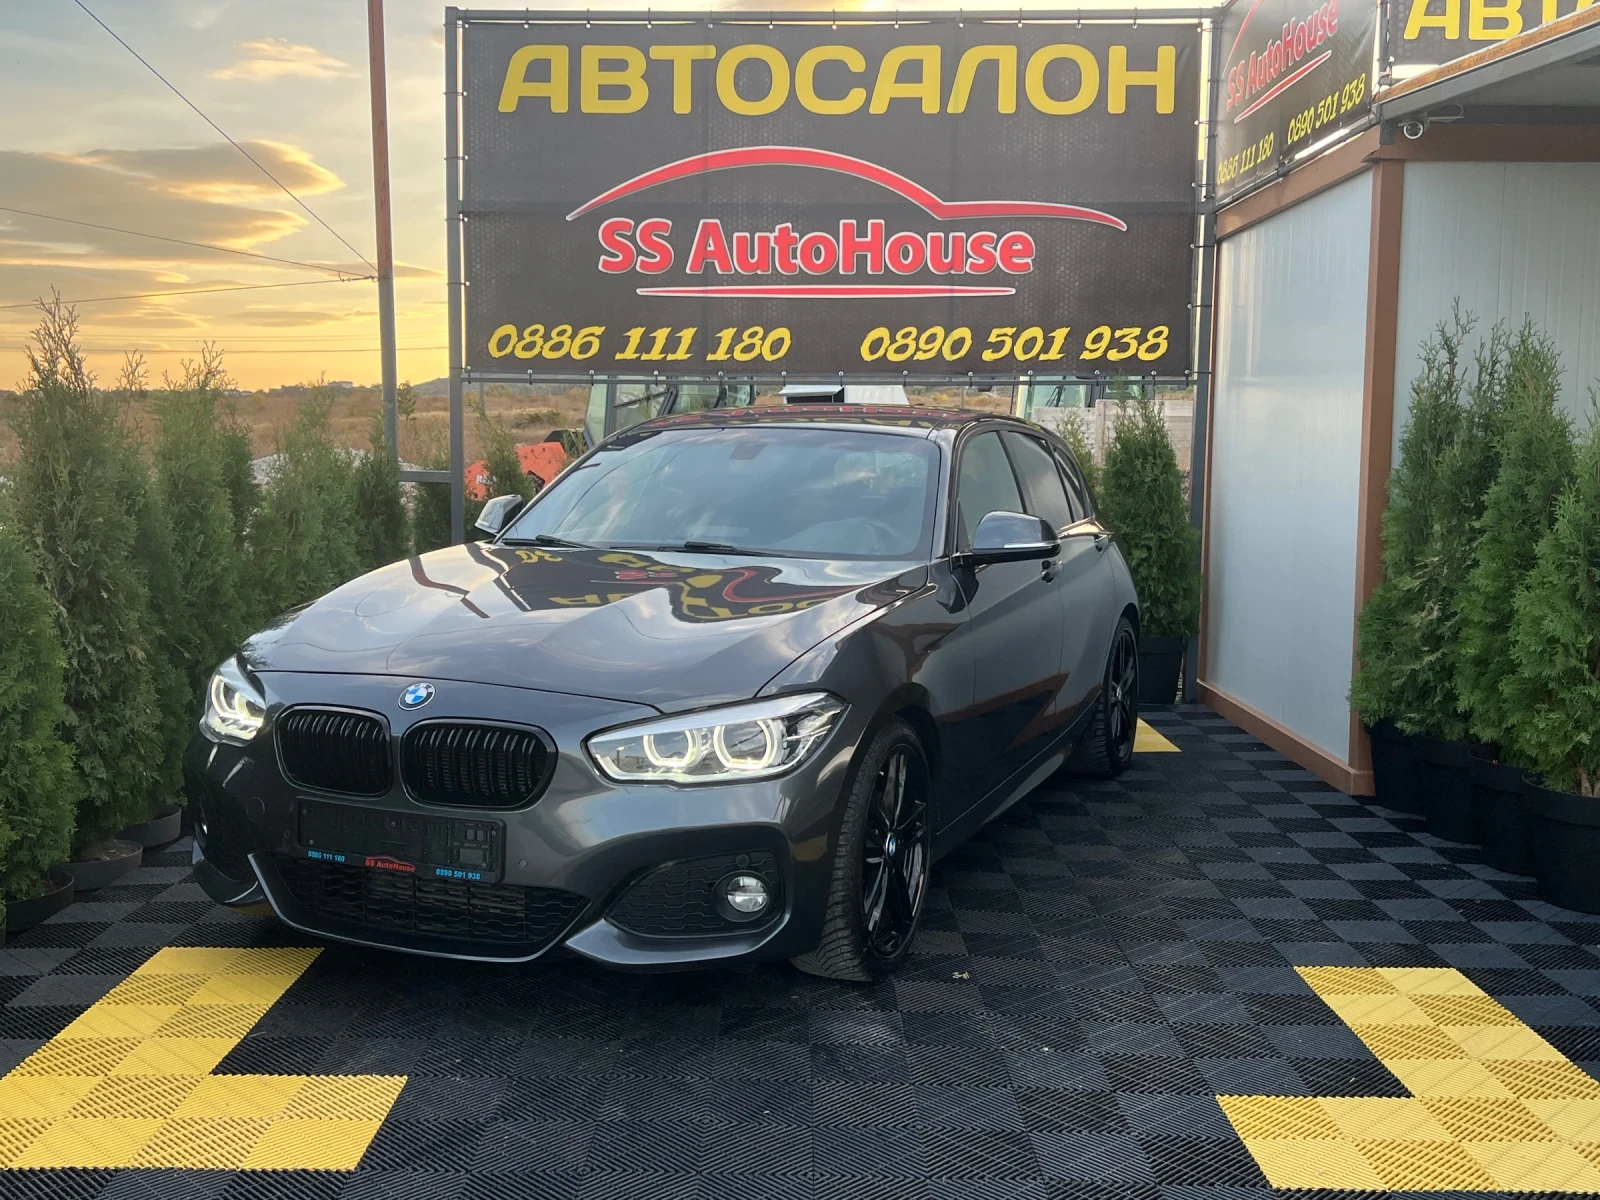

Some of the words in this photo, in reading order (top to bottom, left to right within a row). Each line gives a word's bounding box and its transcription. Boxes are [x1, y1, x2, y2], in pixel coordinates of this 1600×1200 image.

[1404, 0, 1592, 40] АВ
[498, 44, 1177, 115] АВТОСАЛОН
[1226, 60, 1245, 112] SS
[1245, 0, 1339, 100] AutoHouse
[1288, 106, 1315, 145] 0890
[1316, 91, 1339, 129] 501
[1340, 73, 1366, 114] 938
[1217, 153, 1239, 186] 0886
[1240, 143, 1256, 174] 111
[1257, 132, 1274, 165] 180
[598, 217, 675, 275] SS
[685, 217, 1035, 276] AutoHouse
[487, 324, 604, 361] 0886
[614, 326, 697, 361] 111
[706, 325, 792, 362] 180
[860, 325, 973, 363] 0890
[981, 325, 1071, 362] 501
[1079, 324, 1170, 362] 938
[365, 859, 375, 867] SS
[376, 860, 416, 872] AutoHouse
[453, 870, 466, 878] 501
